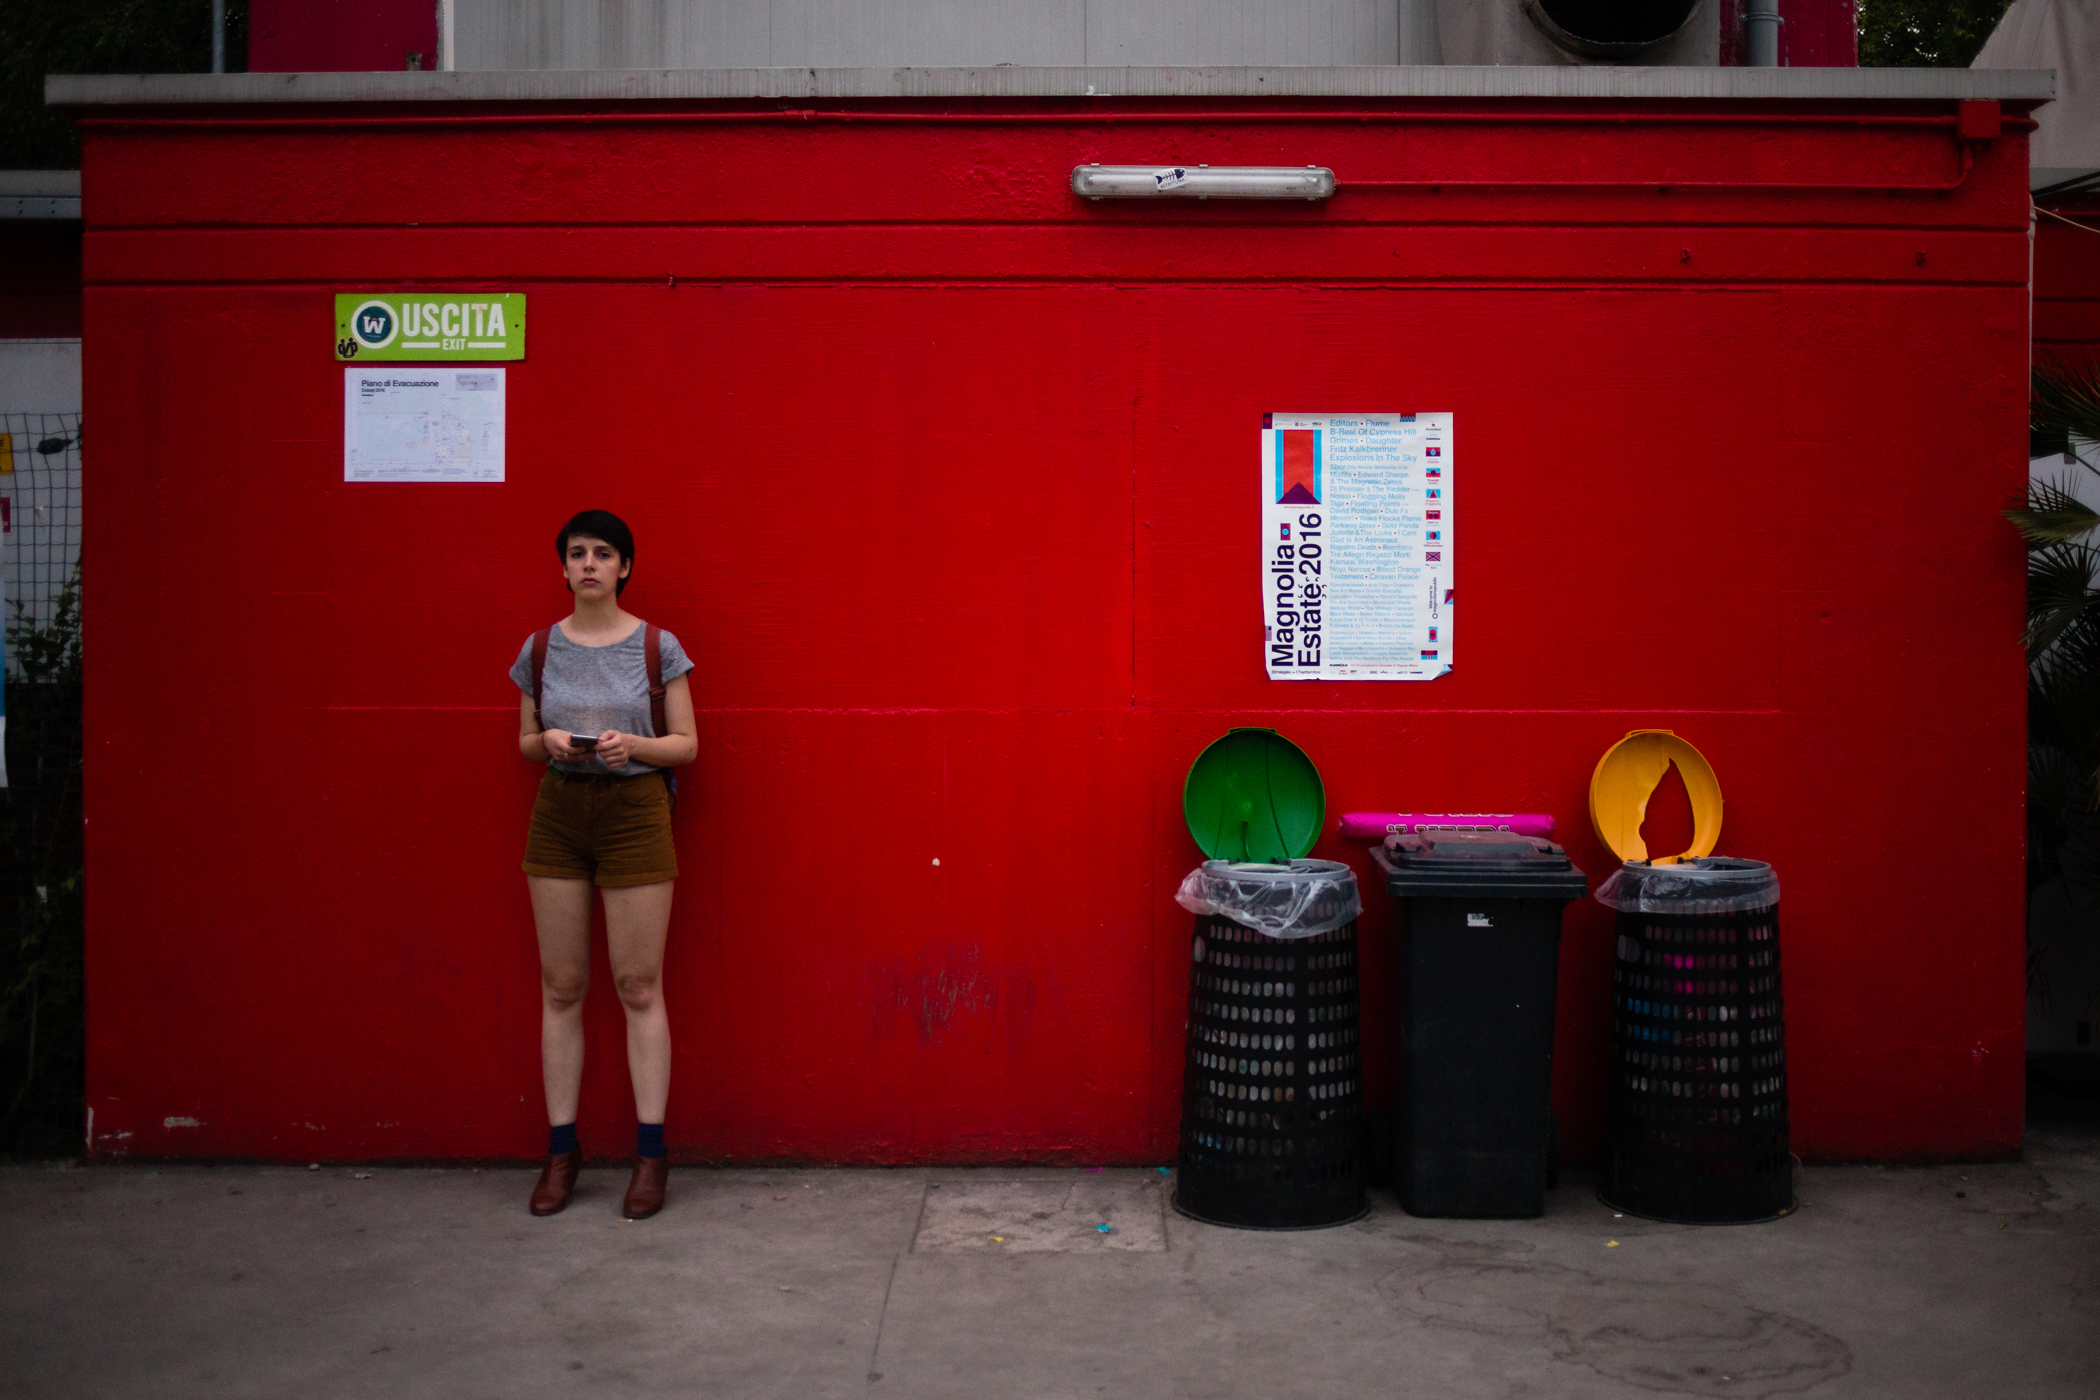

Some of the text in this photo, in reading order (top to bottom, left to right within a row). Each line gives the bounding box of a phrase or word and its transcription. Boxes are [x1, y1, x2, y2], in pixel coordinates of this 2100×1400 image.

[402, 303, 506, 337] USCITA
[442, 338, 467, 351] EXIT
[361, 379, 439, 387] Piano di Evacuazione
[1330, 419, 1358, 427] Editors
[1366, 419, 1390, 427] Flume
[1330, 428, 1417, 437] B-Real Of Cypress Hill
[1330, 437, 1402, 445] Grimes Daughter
[1330, 454, 1374, 463] Explosions
[1376, 454, 1383, 463] In
[1386, 454, 1400, 463] The
[1402, 454, 1417, 463] Sky
[1298, 513, 1322, 575] 2016
[1271, 544, 1300, 666] Magnolia
